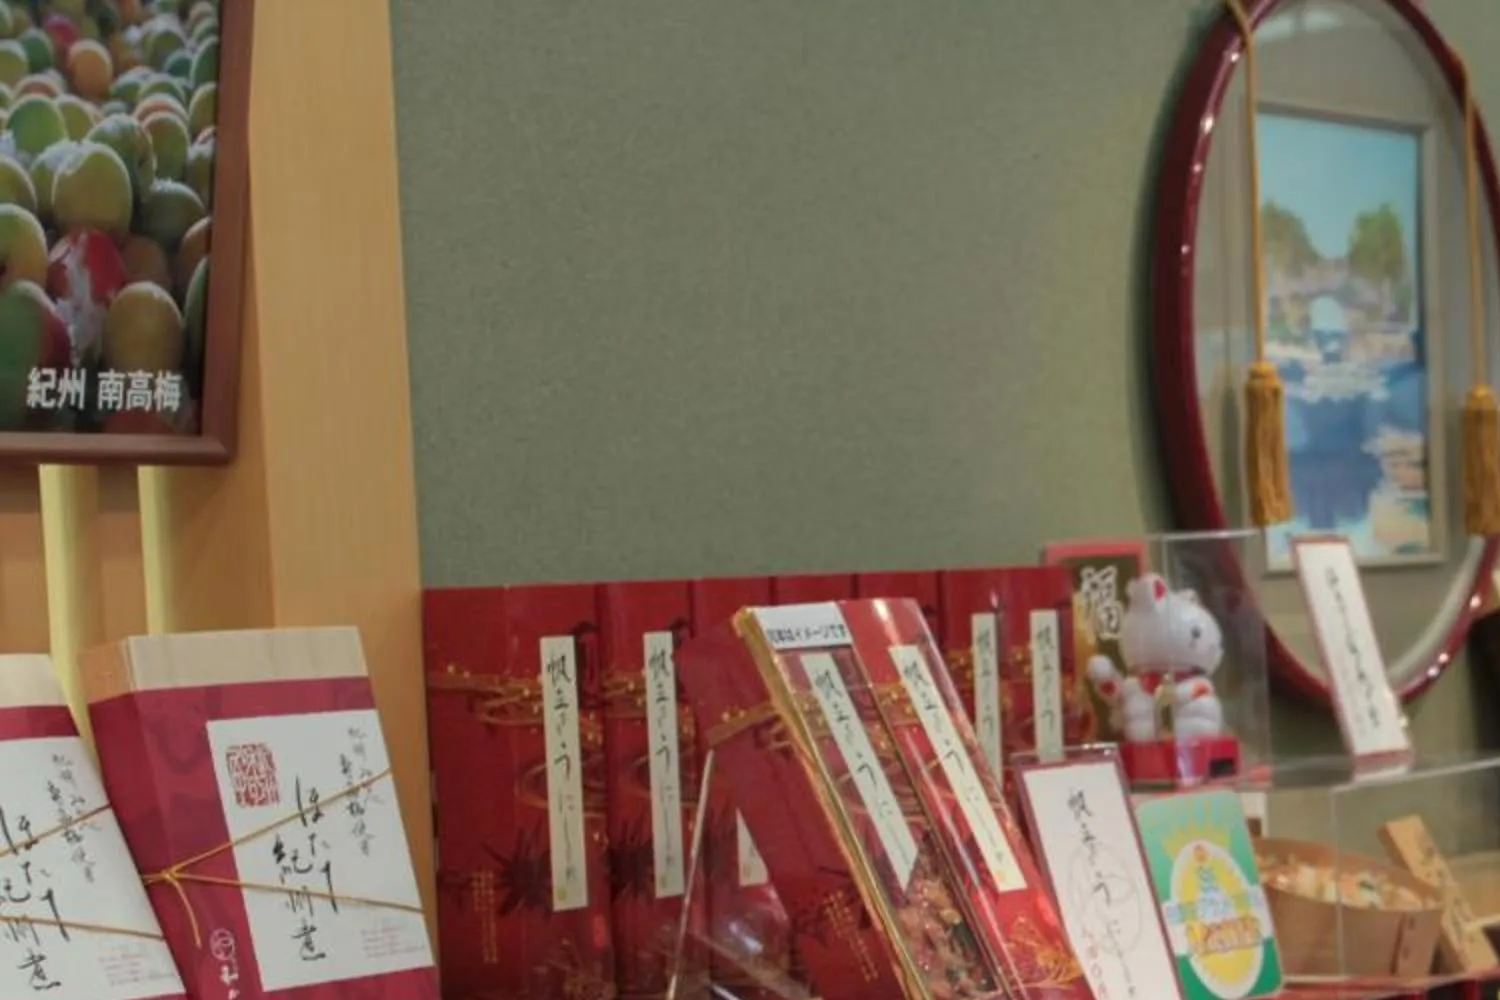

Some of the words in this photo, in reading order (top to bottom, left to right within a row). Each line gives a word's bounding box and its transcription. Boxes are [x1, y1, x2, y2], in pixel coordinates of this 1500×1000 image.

[27, 366, 86, 410] 紀州
[97, 368, 183, 413] 南高梅
